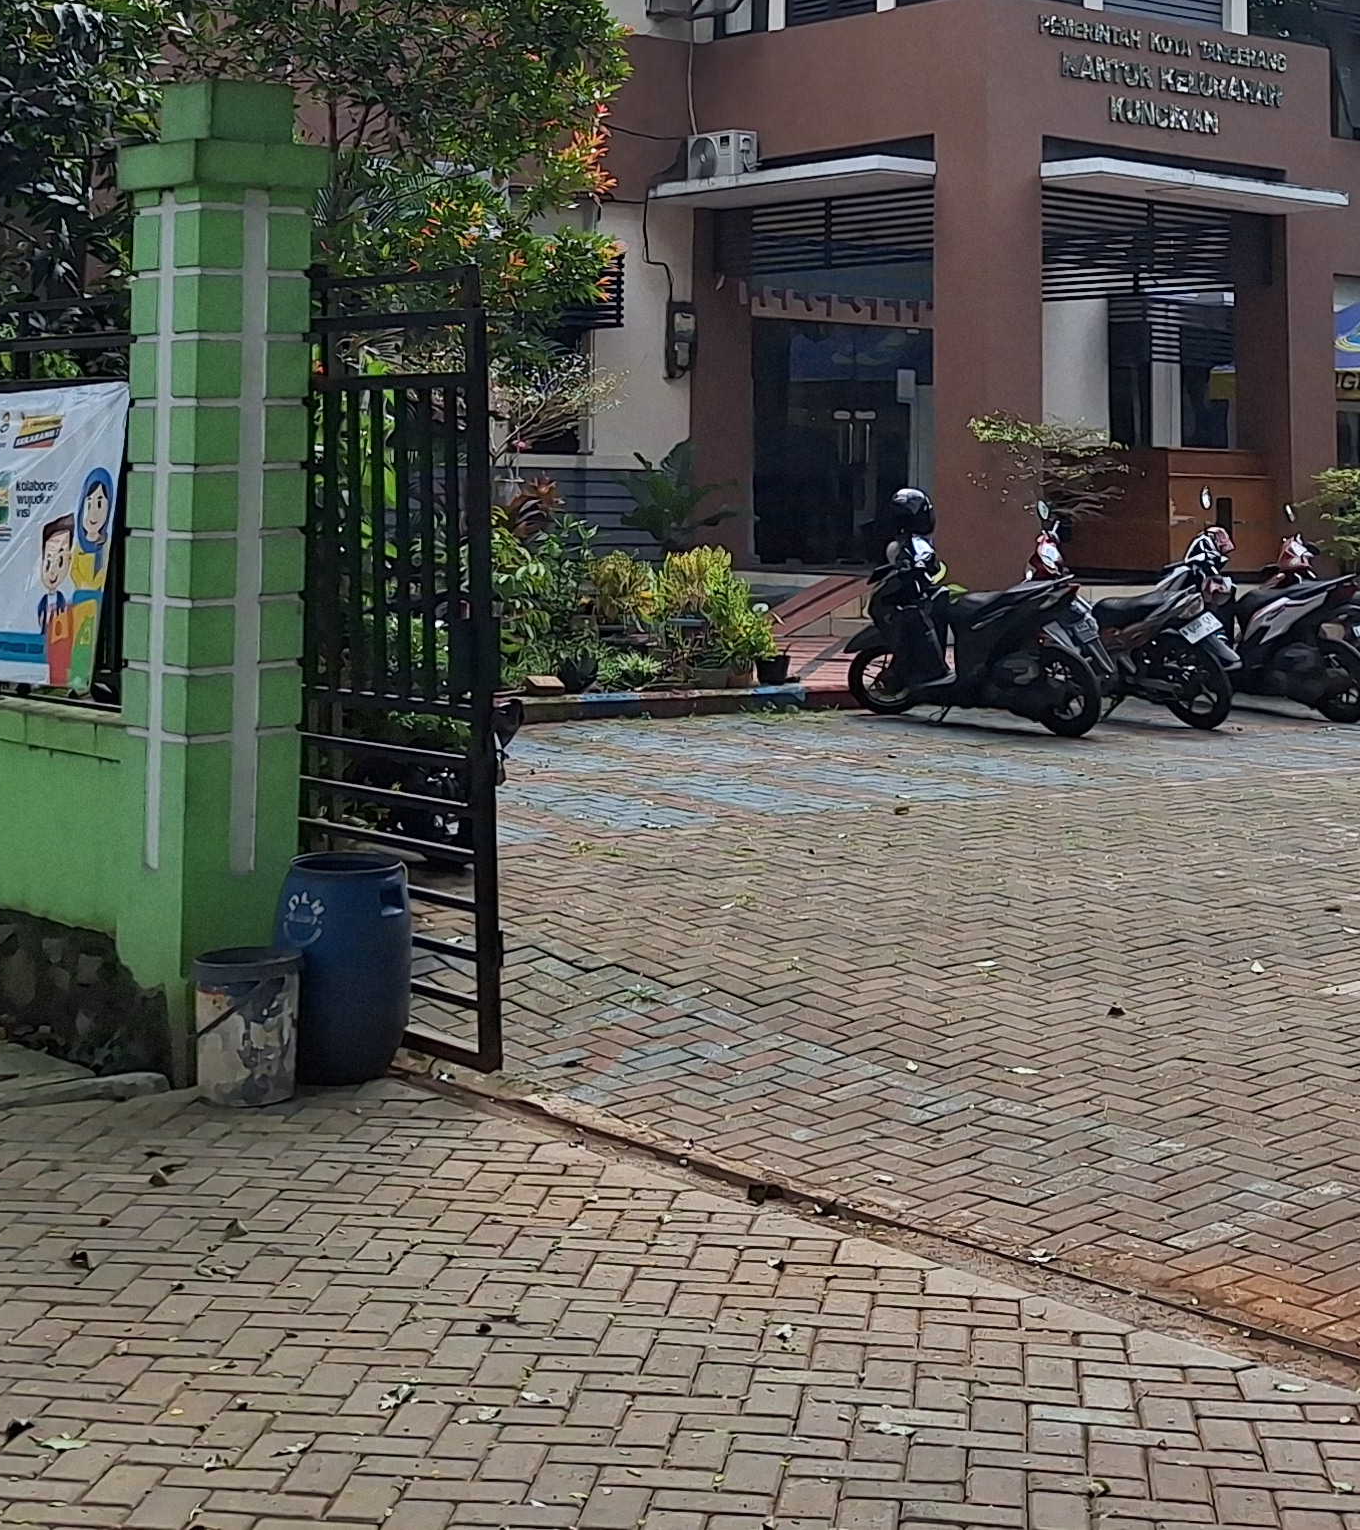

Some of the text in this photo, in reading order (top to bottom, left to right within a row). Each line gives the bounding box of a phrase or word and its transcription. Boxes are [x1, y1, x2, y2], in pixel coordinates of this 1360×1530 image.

[1038, 14, 1288, 73] PEMERINTAH KOTA TANGERANG
[1061, 51, 1283, 108] KANTOR KELURAHAN
[1108, 95, 1221, 135] KUNCIRAN
